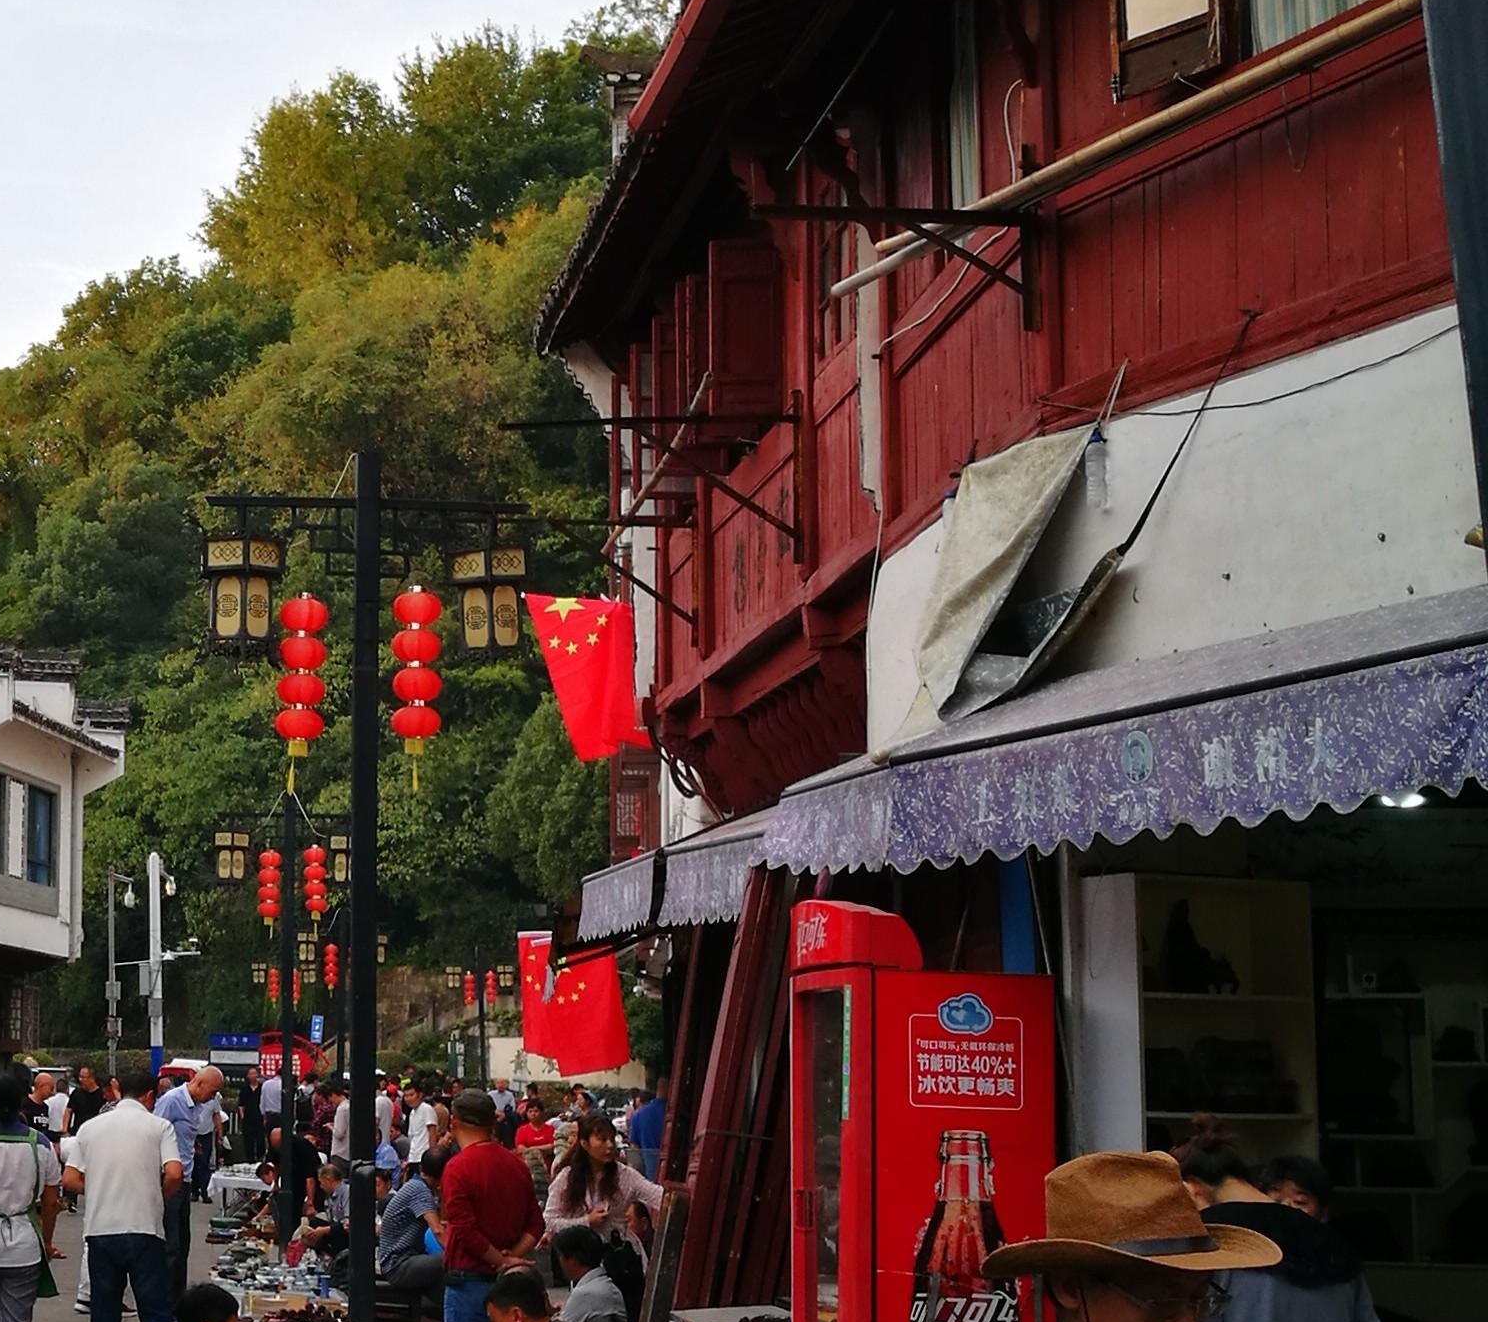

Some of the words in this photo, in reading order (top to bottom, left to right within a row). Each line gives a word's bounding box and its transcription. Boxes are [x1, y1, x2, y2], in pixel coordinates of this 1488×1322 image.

[916, 1053, 1016, 1075] 节能可达40%+
[917, 1074, 1016, 1097] 冰饮更畅爽
